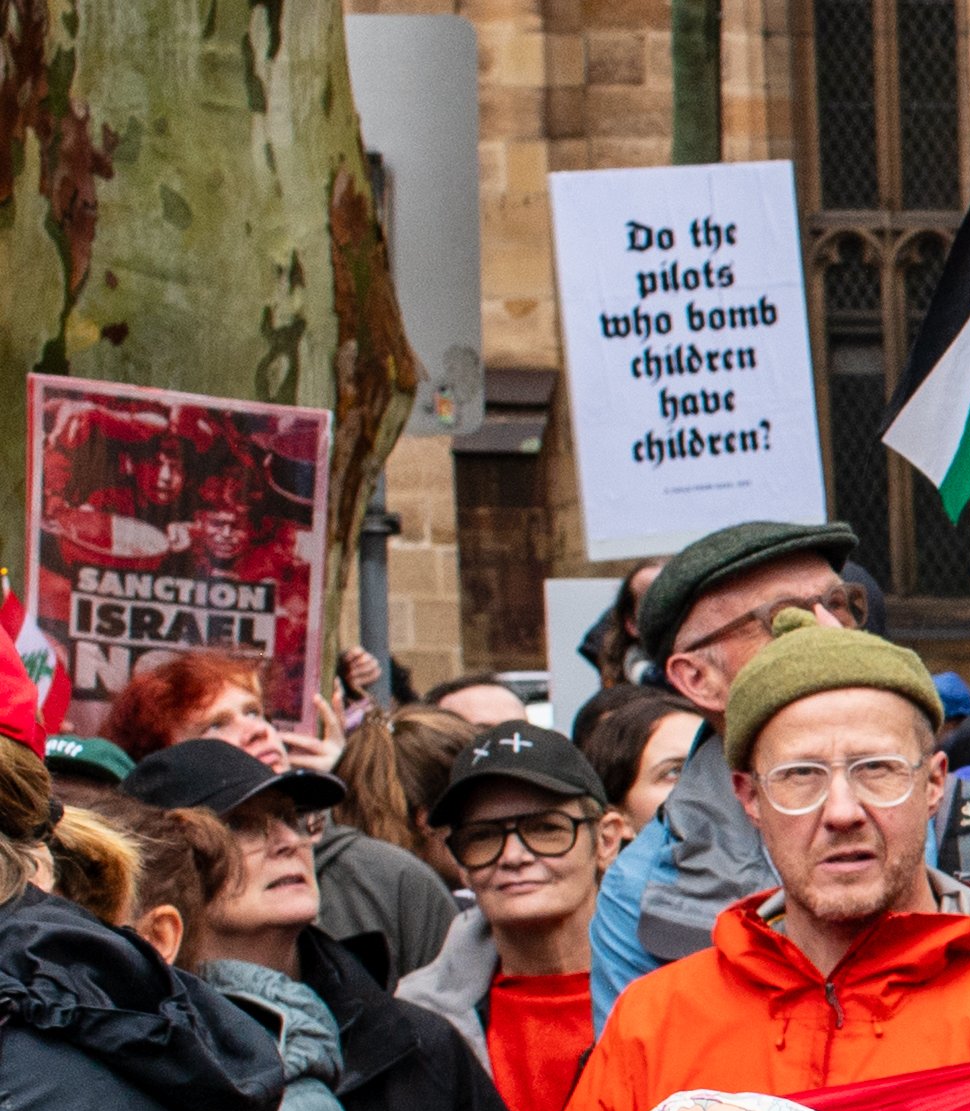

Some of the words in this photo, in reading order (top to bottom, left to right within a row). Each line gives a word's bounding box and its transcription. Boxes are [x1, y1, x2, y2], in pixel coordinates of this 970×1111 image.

[625, 220, 675, 252] Do
[690, 215, 737, 254] the
[636, 260, 735, 298] pilots
[600, 304, 673, 342] who
[687, 295, 777, 331] bomb
[630, 344, 757, 385] children
[659, 386, 736, 424] have
[632, 419, 772, 467] children?
[78, 566, 267, 610] SANCTION
[76, 597, 267, 653] ISRAEL
